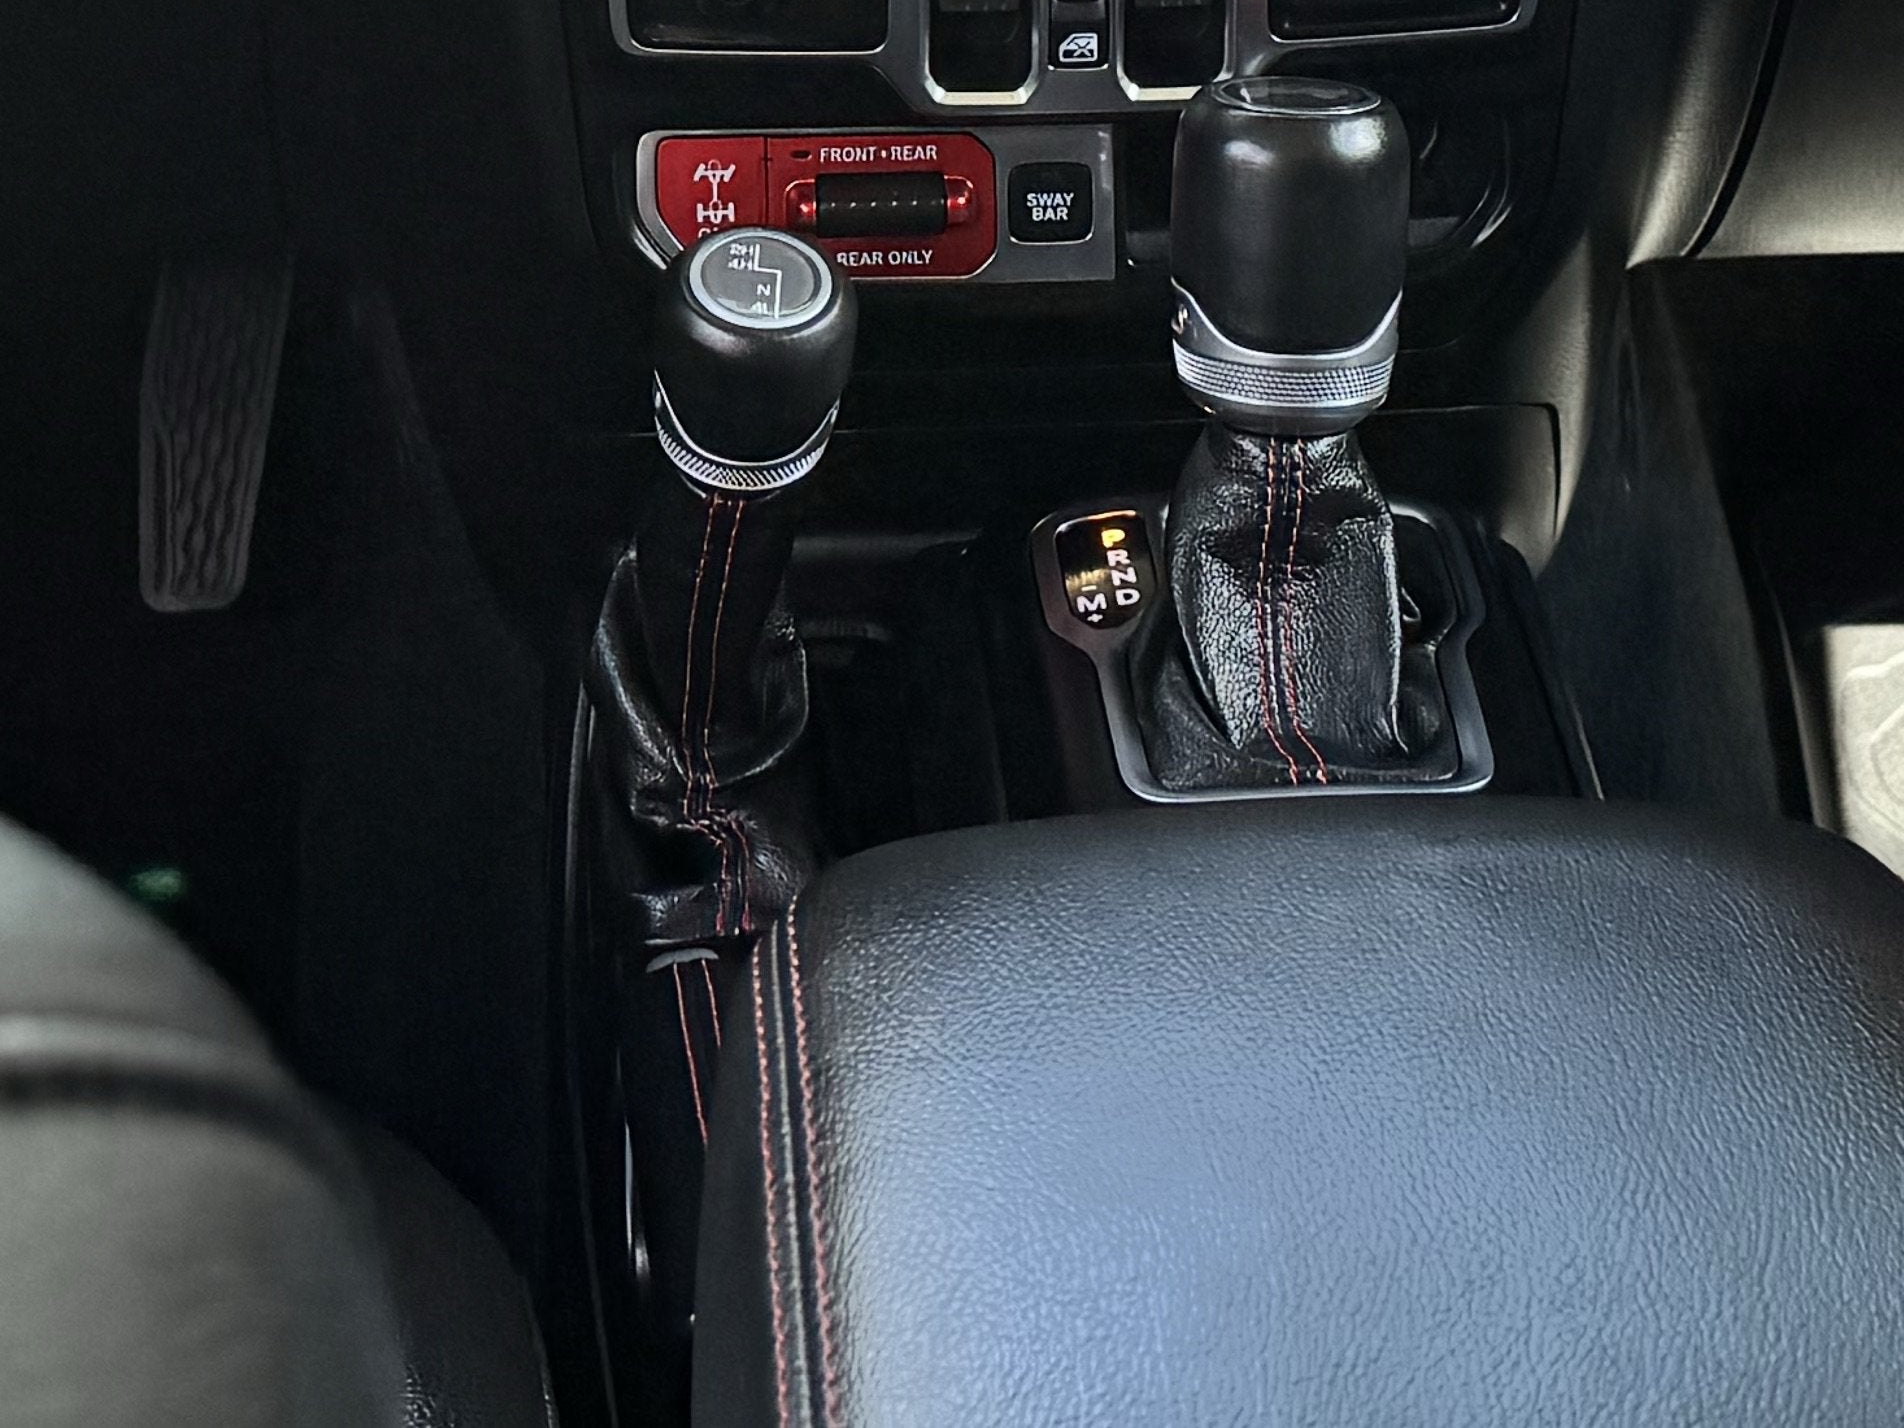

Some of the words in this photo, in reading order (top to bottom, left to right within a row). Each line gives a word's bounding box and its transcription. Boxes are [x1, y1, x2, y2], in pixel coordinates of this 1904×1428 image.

[819, 146, 877, 164] FRONT
[890, 144, 938, 162] REAR
[1026, 191, 1074, 207] SWAY
[1031, 206, 1069, 221] BAR
[837, 250, 884, 267] REAR
[888, 249, 934, 265] ONLY
[756, 283, 771, 297] N
[1101, 528, 1126, 548] P
[1106, 549, 1131, 567] R
[1110, 566, 1137, 586] N
[1076, 592, 1107, 612] M
[1115, 588, 1141, 605] D
